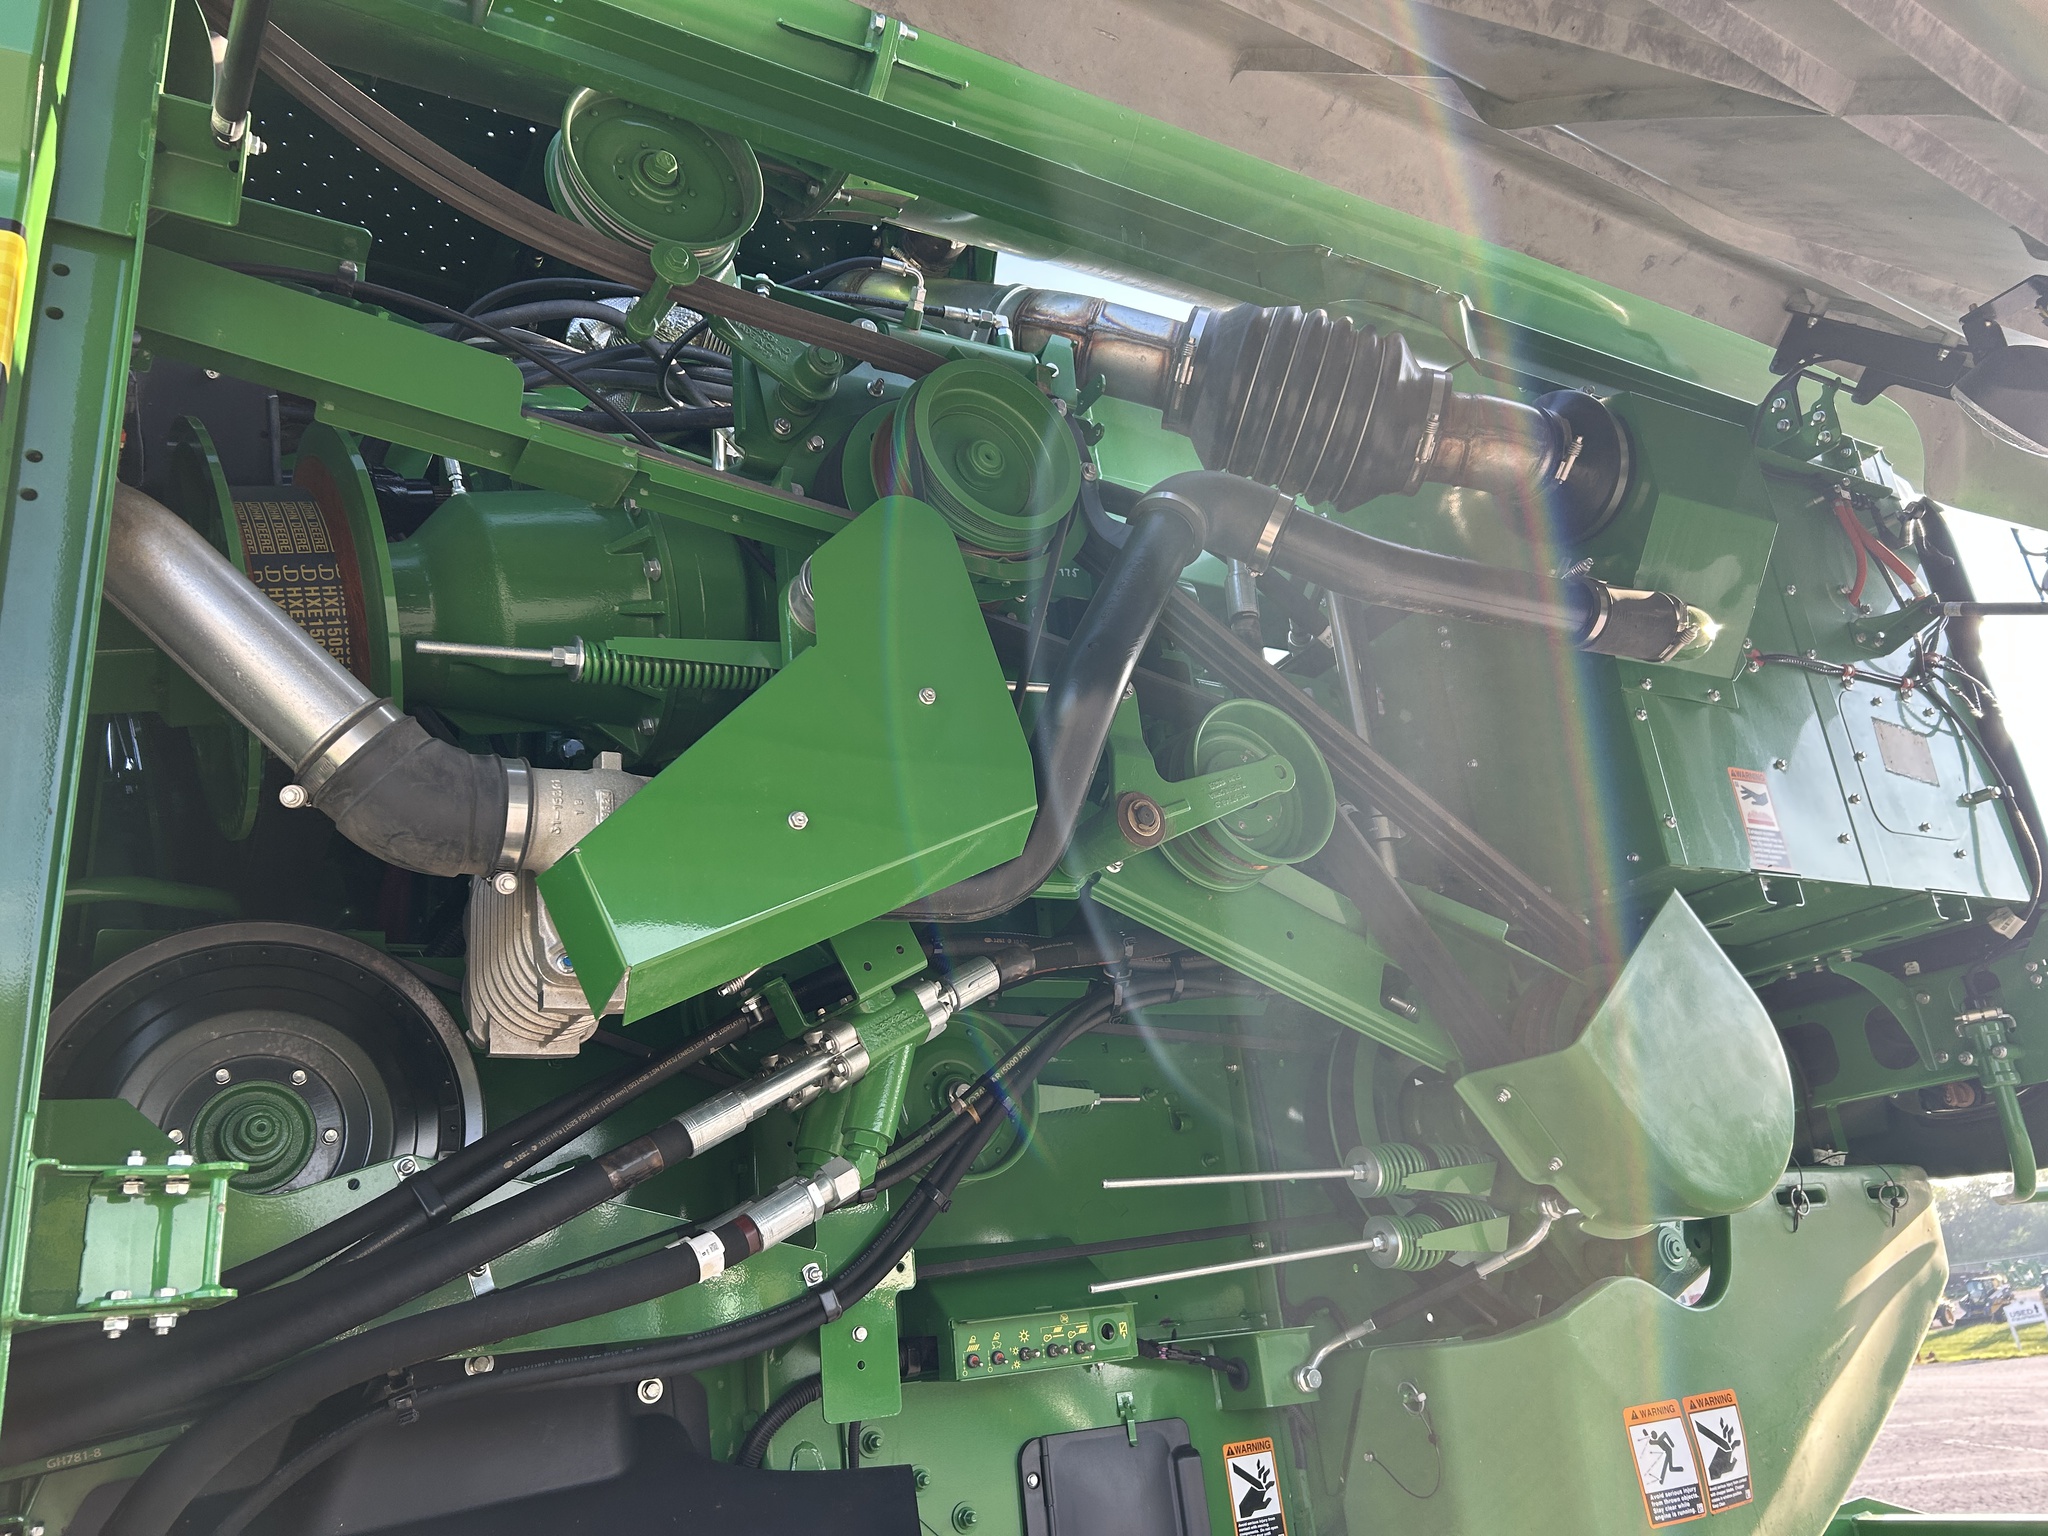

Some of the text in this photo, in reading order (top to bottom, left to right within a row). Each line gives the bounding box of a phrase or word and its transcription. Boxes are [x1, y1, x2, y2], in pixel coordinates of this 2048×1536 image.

[248, 501, 263, 521] JOHN
[256, 523, 272, 552] DEERE
[266, 500, 281, 521] JOHN
[274, 523, 290, 552] DEERE
[283, 500, 298, 521] JOHN
[292, 523, 308, 551] DEERE
[300, 499, 316, 521] JOHN
[309, 523, 326, 551] DEERE
[1735, 770, 1766, 781] WARNING
[2010, 1309, 2033, 1317] USED
[1695, 1393, 1732, 1408] WARNING
[1639, 1404, 1675, 1418] WARNING
[1234, 1441, 1270, 1453] WARNING
[47, 1449, 102, 1468] GH781-8
[1650, 1486, 1696, 1500] Avoid serious injury
[1651, 1492, 1699, 1507] from thrown objects.
[1653, 1500, 1690, 1515] Stay clear while
[1655, 1512, 1671, 1521] engine
[1677, 1506, 1696, 1516] running.
